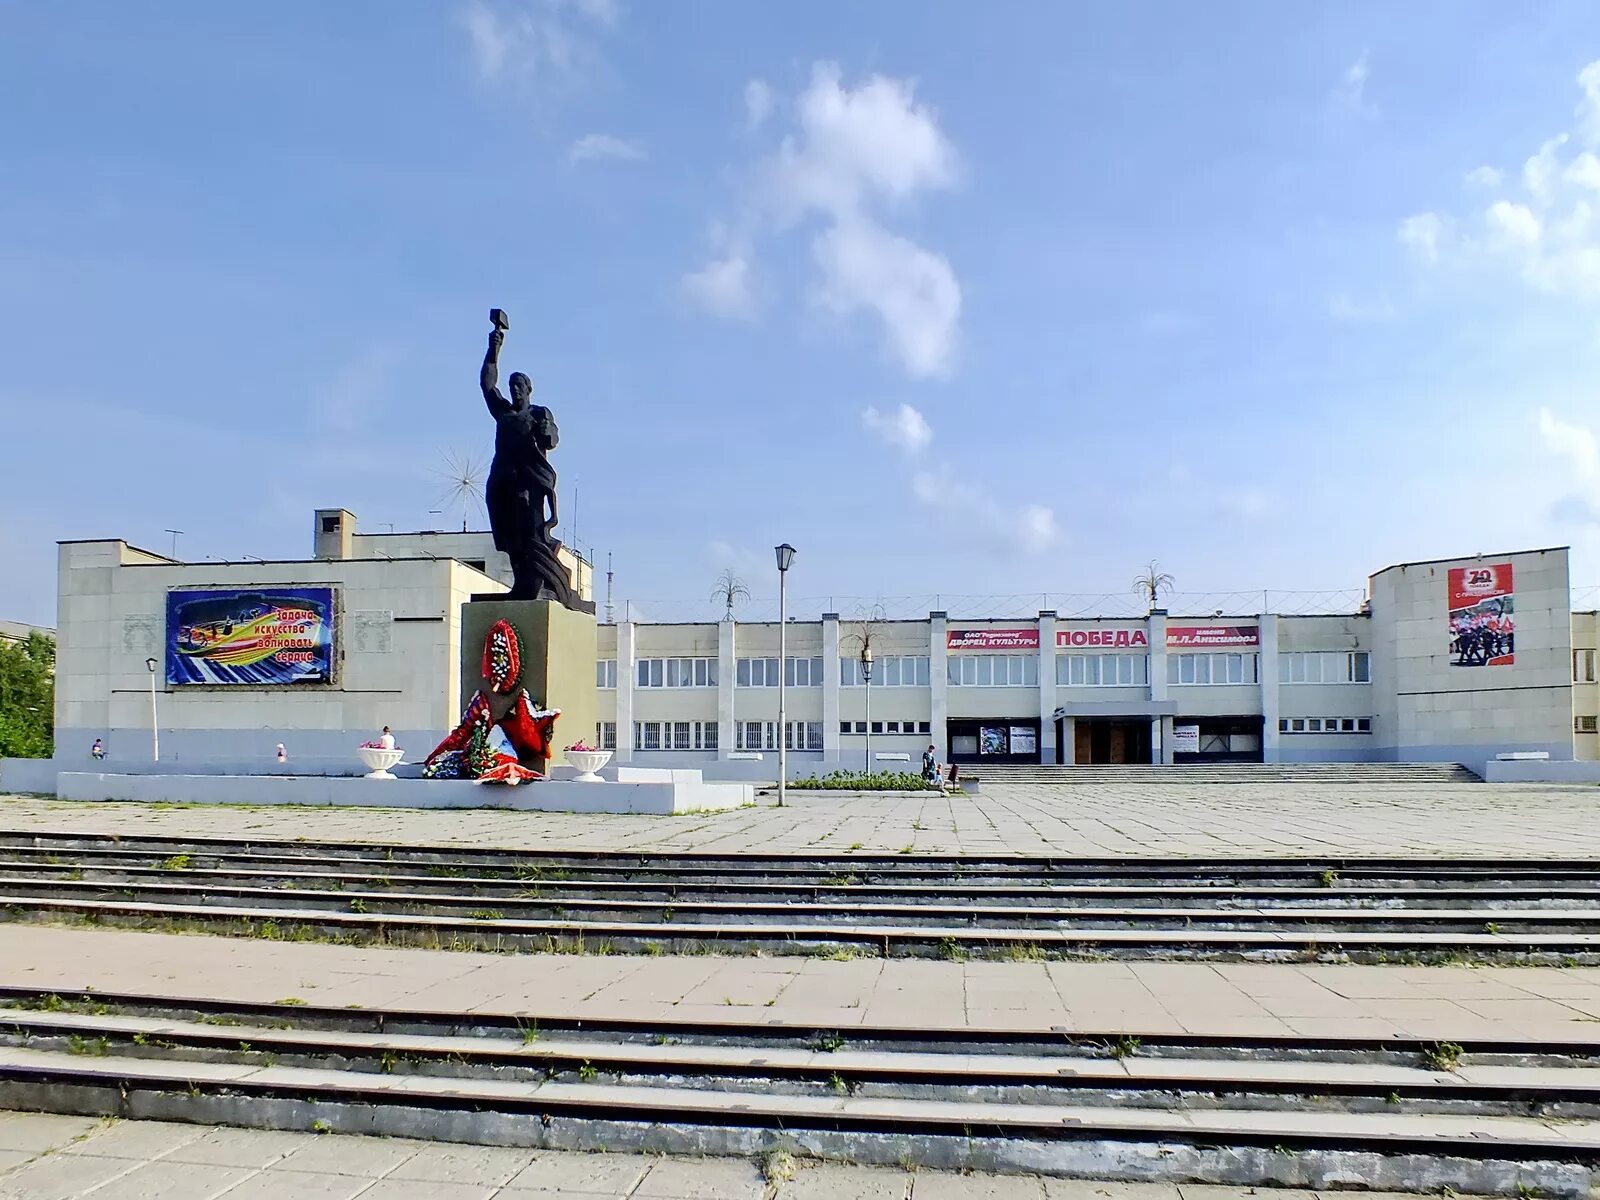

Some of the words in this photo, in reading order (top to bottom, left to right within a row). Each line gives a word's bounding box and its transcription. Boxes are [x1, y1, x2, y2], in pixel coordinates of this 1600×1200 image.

[1468, 570, 1492, 584] 70
[276, 609, 313, 621] Задача
[254, 625, 305, 636] искусства
[258, 638, 313, 648] волновать
[949, 638, 986, 646] ДВОРЕЦ
[989, 638, 1037, 646] КУЛЬТУРЫ
[1056, 630, 1147, 647] ПОБЕДА
[276, 652, 313, 662] сердца
